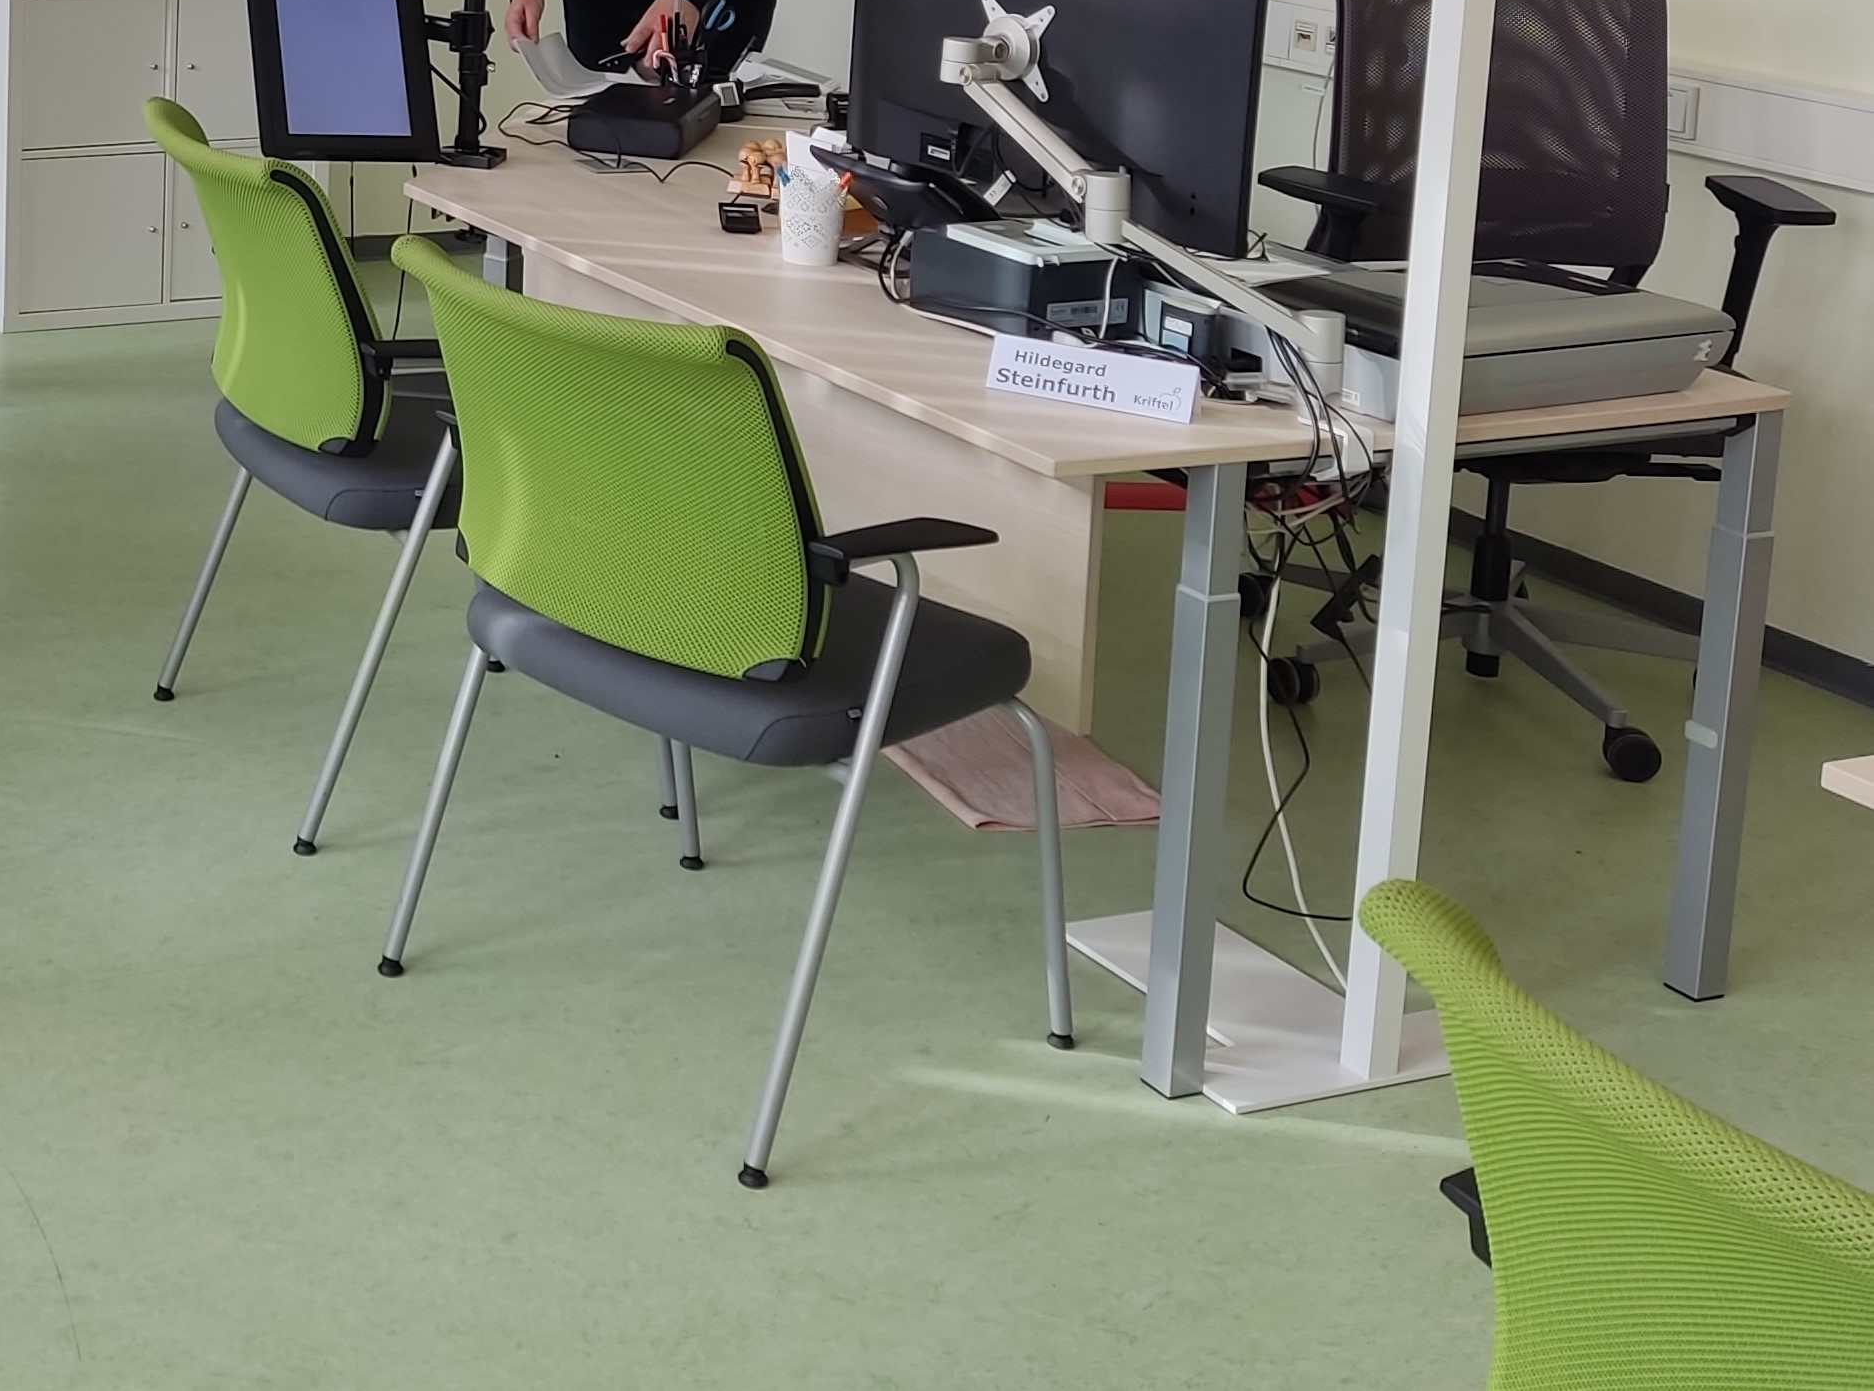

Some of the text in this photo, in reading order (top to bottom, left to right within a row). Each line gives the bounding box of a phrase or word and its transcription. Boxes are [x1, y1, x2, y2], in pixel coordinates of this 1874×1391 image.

[1014, 349, 1107, 377] Hildegard
[995, 367, 1116, 403] Steinfurth
[1133, 394, 1174, 411] Kriftel
